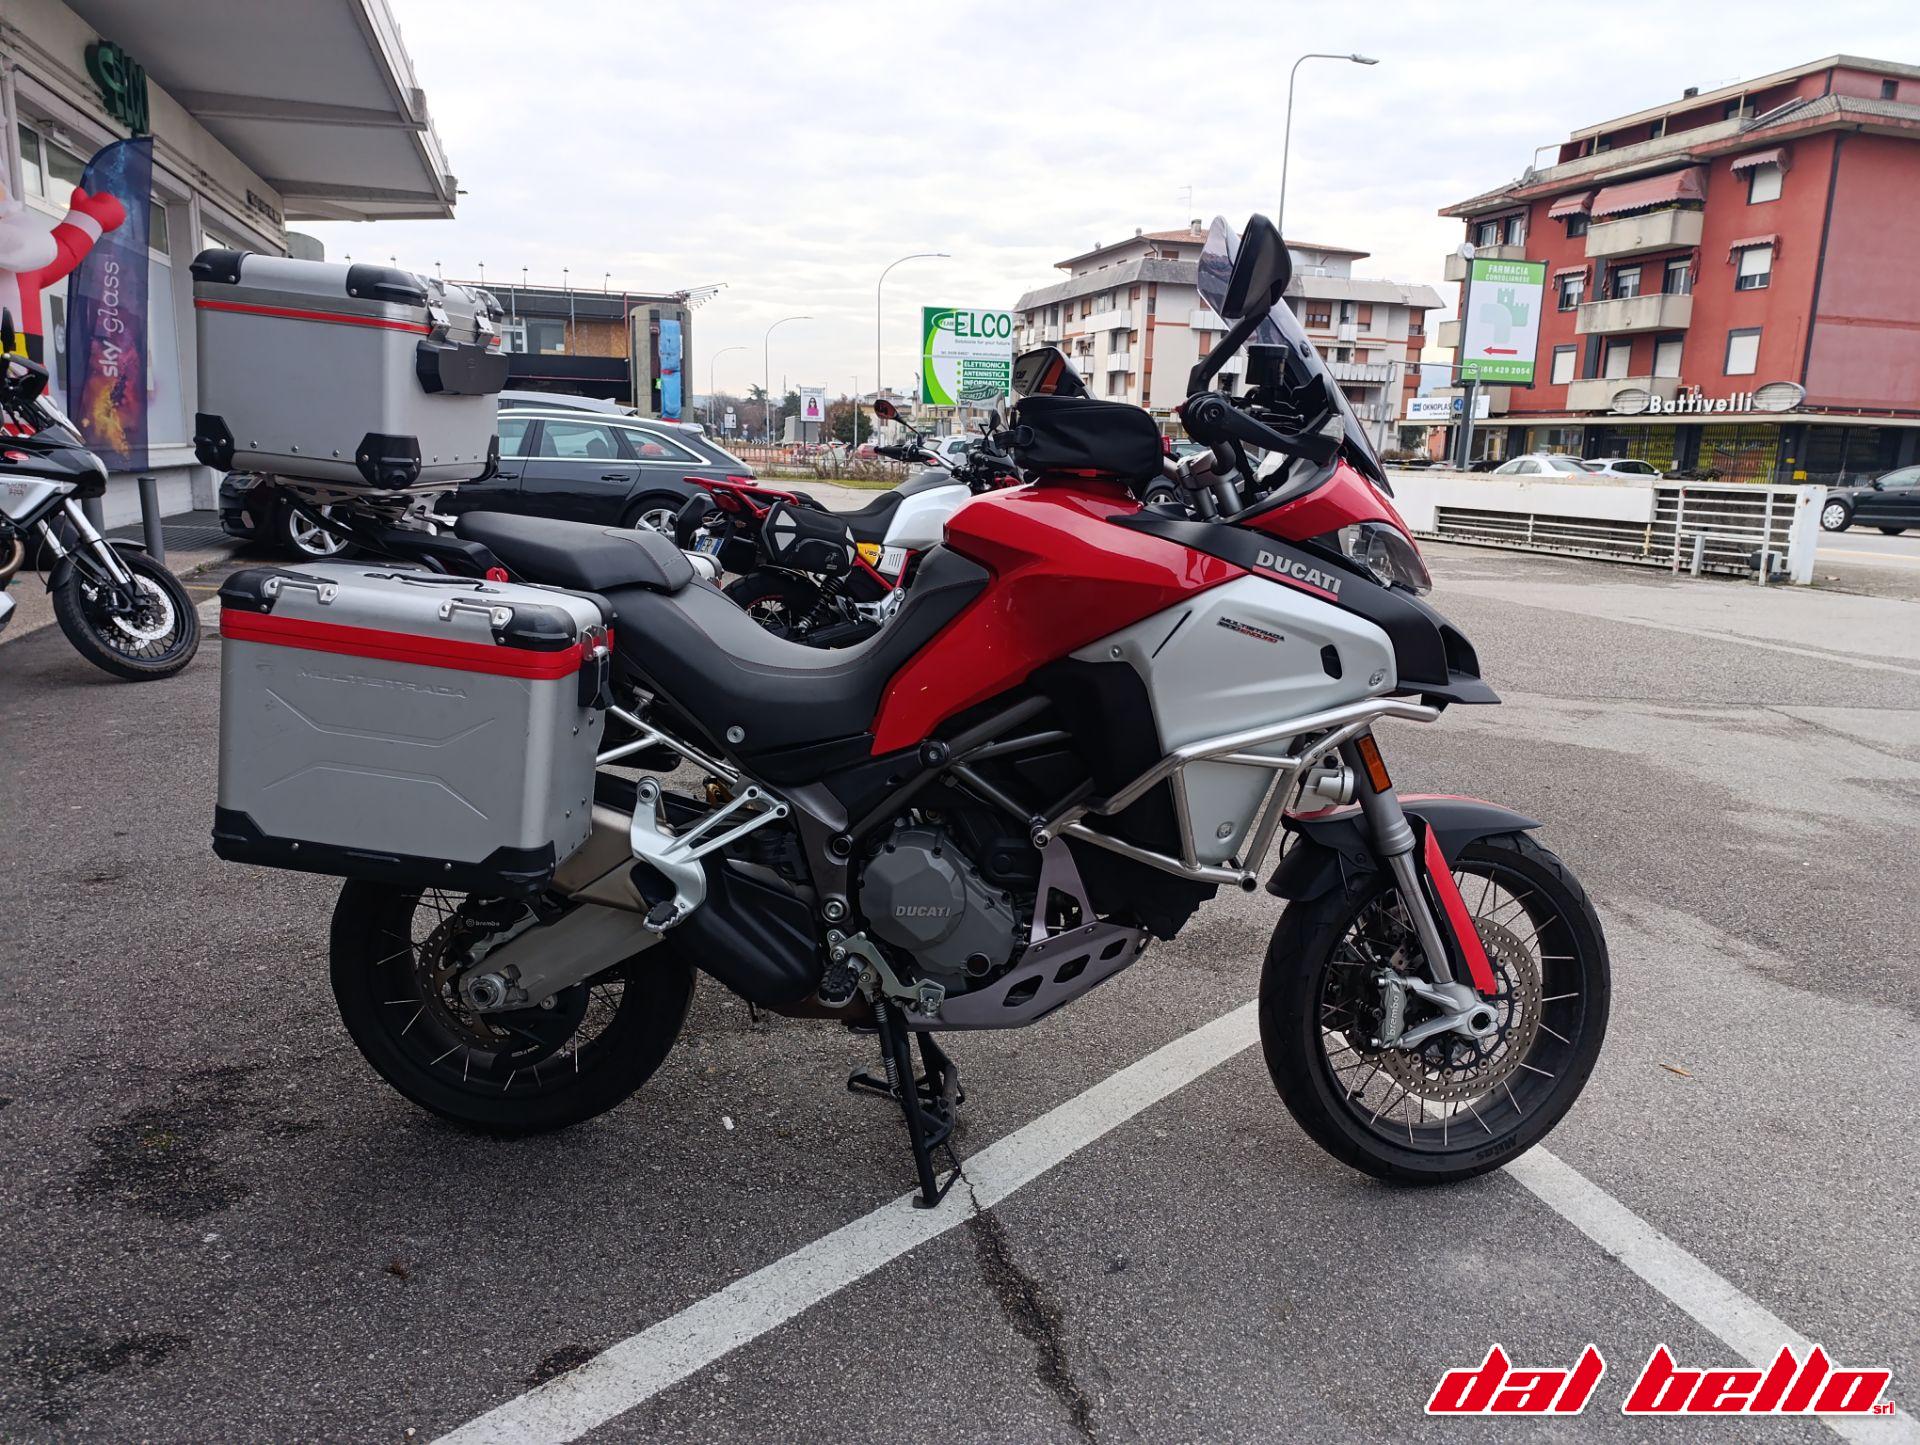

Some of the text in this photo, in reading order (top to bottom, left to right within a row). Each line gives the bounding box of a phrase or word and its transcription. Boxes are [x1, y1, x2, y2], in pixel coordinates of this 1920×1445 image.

[1488, 265, 1529, 275] FARMACIA
[97, 261, 124, 378] sky glass
[954, 312, 1012, 338] ELCO
[963, 361, 1006, 369] ELETTRONICA
[963, 370, 1006, 378] ANTENNISTICA
[1511, 367, 1531, 375] 2054
[963, 379, 1006, 387] INFORMATICA
[1422, 403, 1451, 411] OKNOPLAS
[1649, 392, 1752, 414] Battivelli
[1255, 550, 1342, 593] DUCATI
[896, 905, 951, 917] DUCATI
[1387, 995, 1400, 1036] brembo
